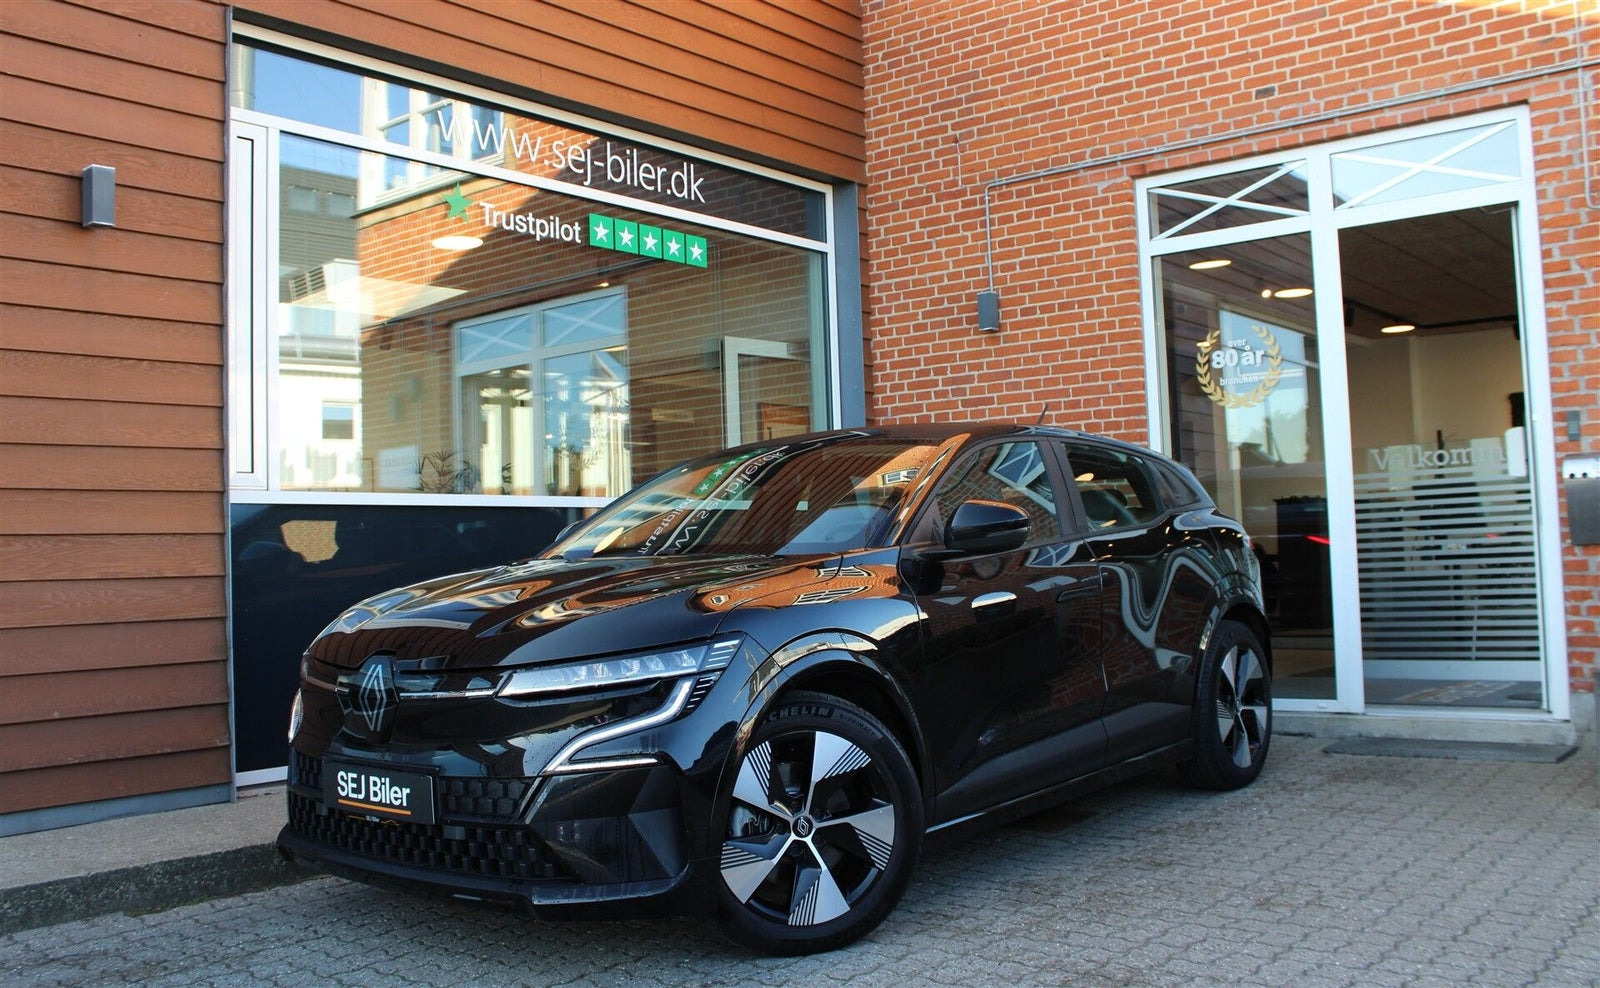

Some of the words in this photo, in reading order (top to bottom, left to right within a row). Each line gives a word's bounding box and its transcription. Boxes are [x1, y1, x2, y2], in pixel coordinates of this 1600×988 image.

[436, 110, 706, 203] www.sej-biler.dk
[479, 201, 582, 243] Trustpilot
[1211, 347, 1239, 369] 80
[1240, 344, 1265, 365] år
[1227, 338, 1247, 348] over
[337, 770, 366, 800] SEJ
[369, 775, 411, 807] Biler
